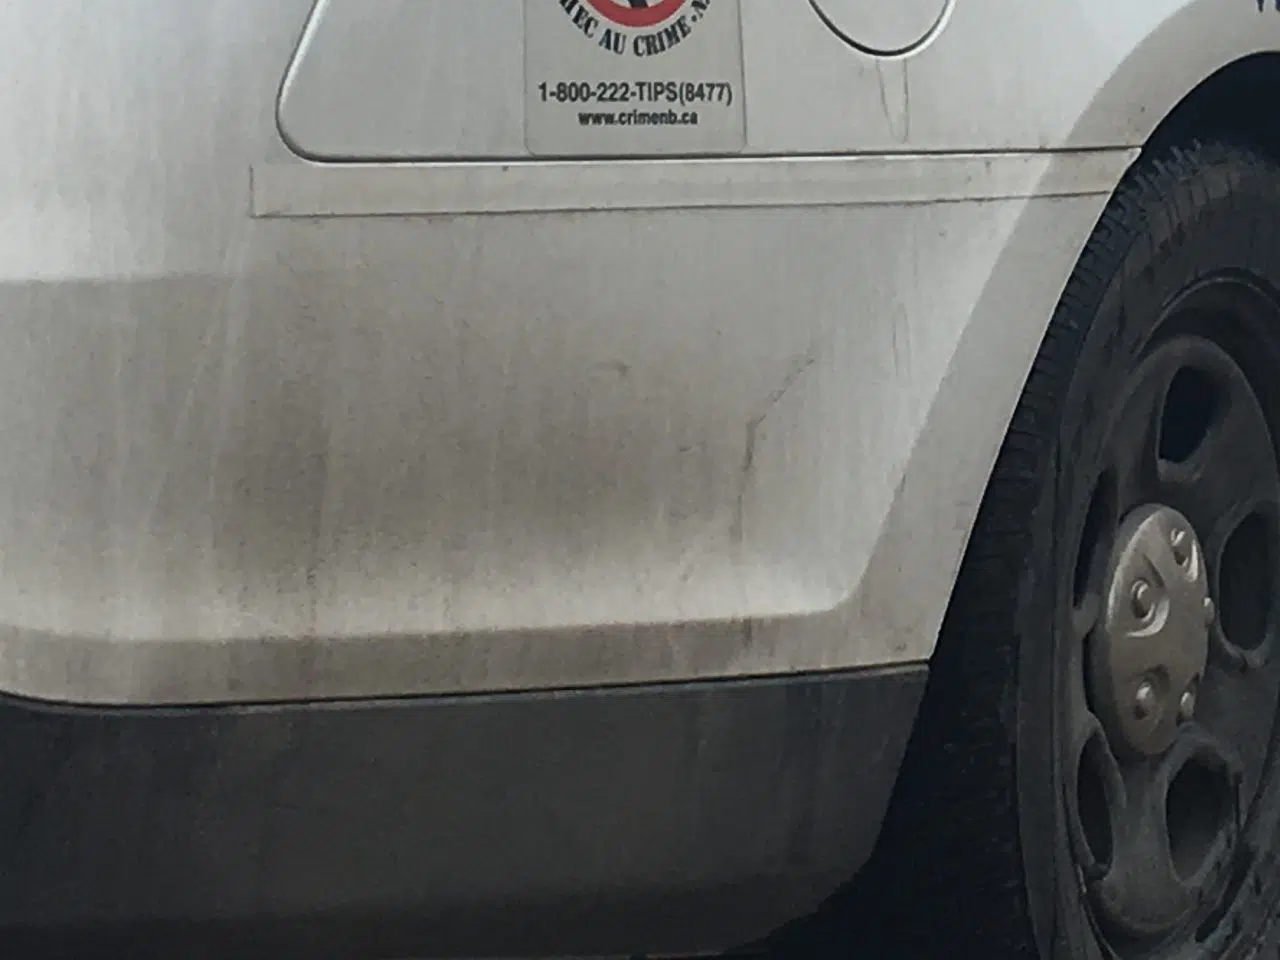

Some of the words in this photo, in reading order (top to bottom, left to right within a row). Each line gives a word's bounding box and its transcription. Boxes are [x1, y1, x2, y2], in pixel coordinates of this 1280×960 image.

[598, 27, 627, 55] AU
[538, 81, 733, 107] 1-800-222-TIPS(8477)
[577, 109, 698, 126] www.crimenb.ca
